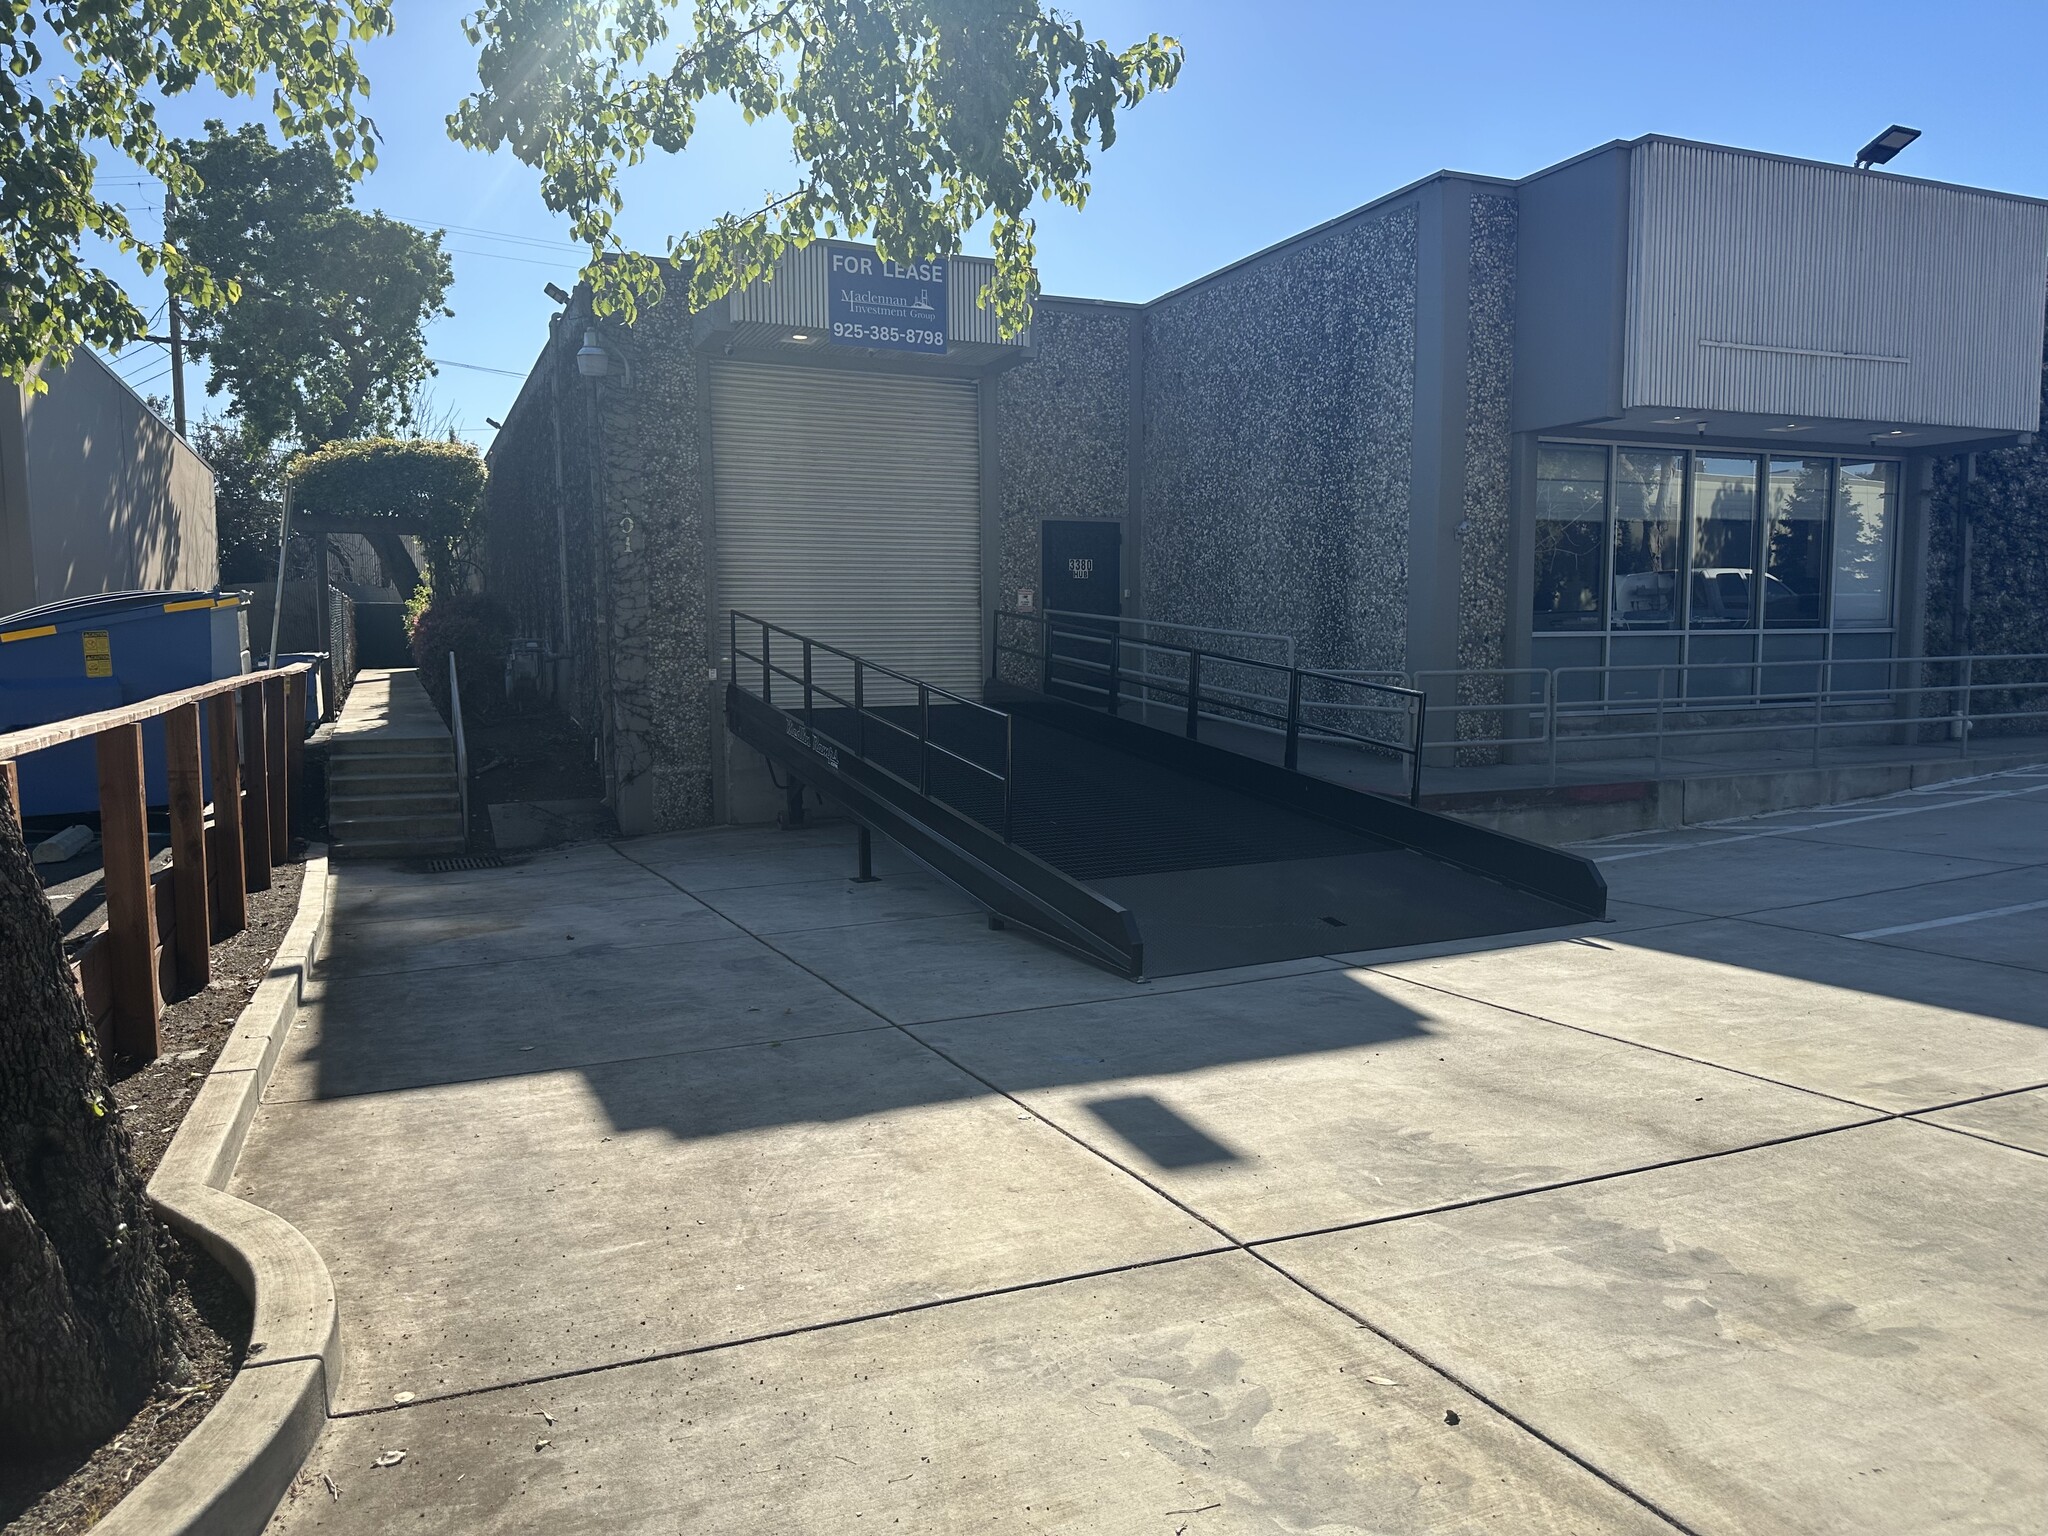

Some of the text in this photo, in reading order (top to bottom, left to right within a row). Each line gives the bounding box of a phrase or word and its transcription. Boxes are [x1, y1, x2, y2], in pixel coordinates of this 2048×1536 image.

[833, 254, 943, 282] FOR LEASE
[841, 289, 907, 306] Maclennan
[850, 301, 936, 322] Investment Group
[833, 322, 944, 345] 925-385-8798
[1069, 559, 1092, 571] 3380
